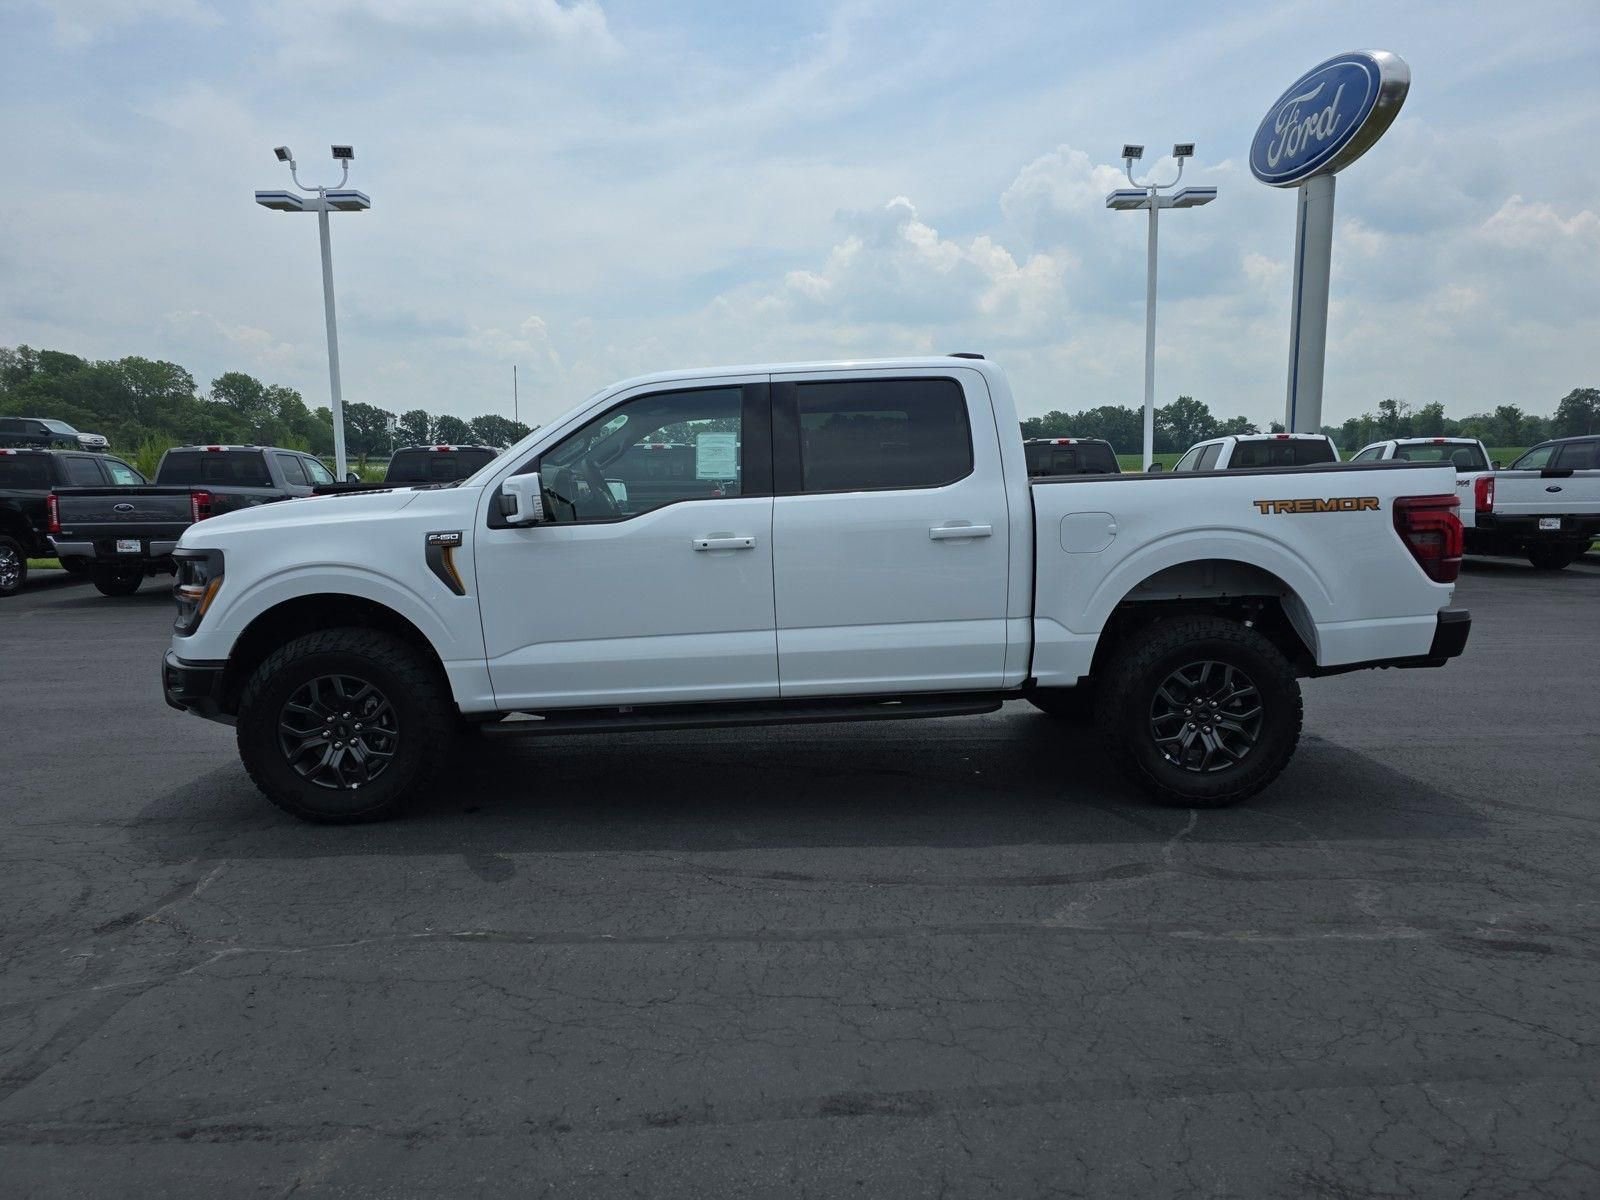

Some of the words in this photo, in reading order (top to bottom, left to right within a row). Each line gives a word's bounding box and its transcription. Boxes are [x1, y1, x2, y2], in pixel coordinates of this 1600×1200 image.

[1267, 81, 1346, 168] Ford
[1253, 496, 1381, 514] TREMOR
[428, 533, 459, 541] F-150
